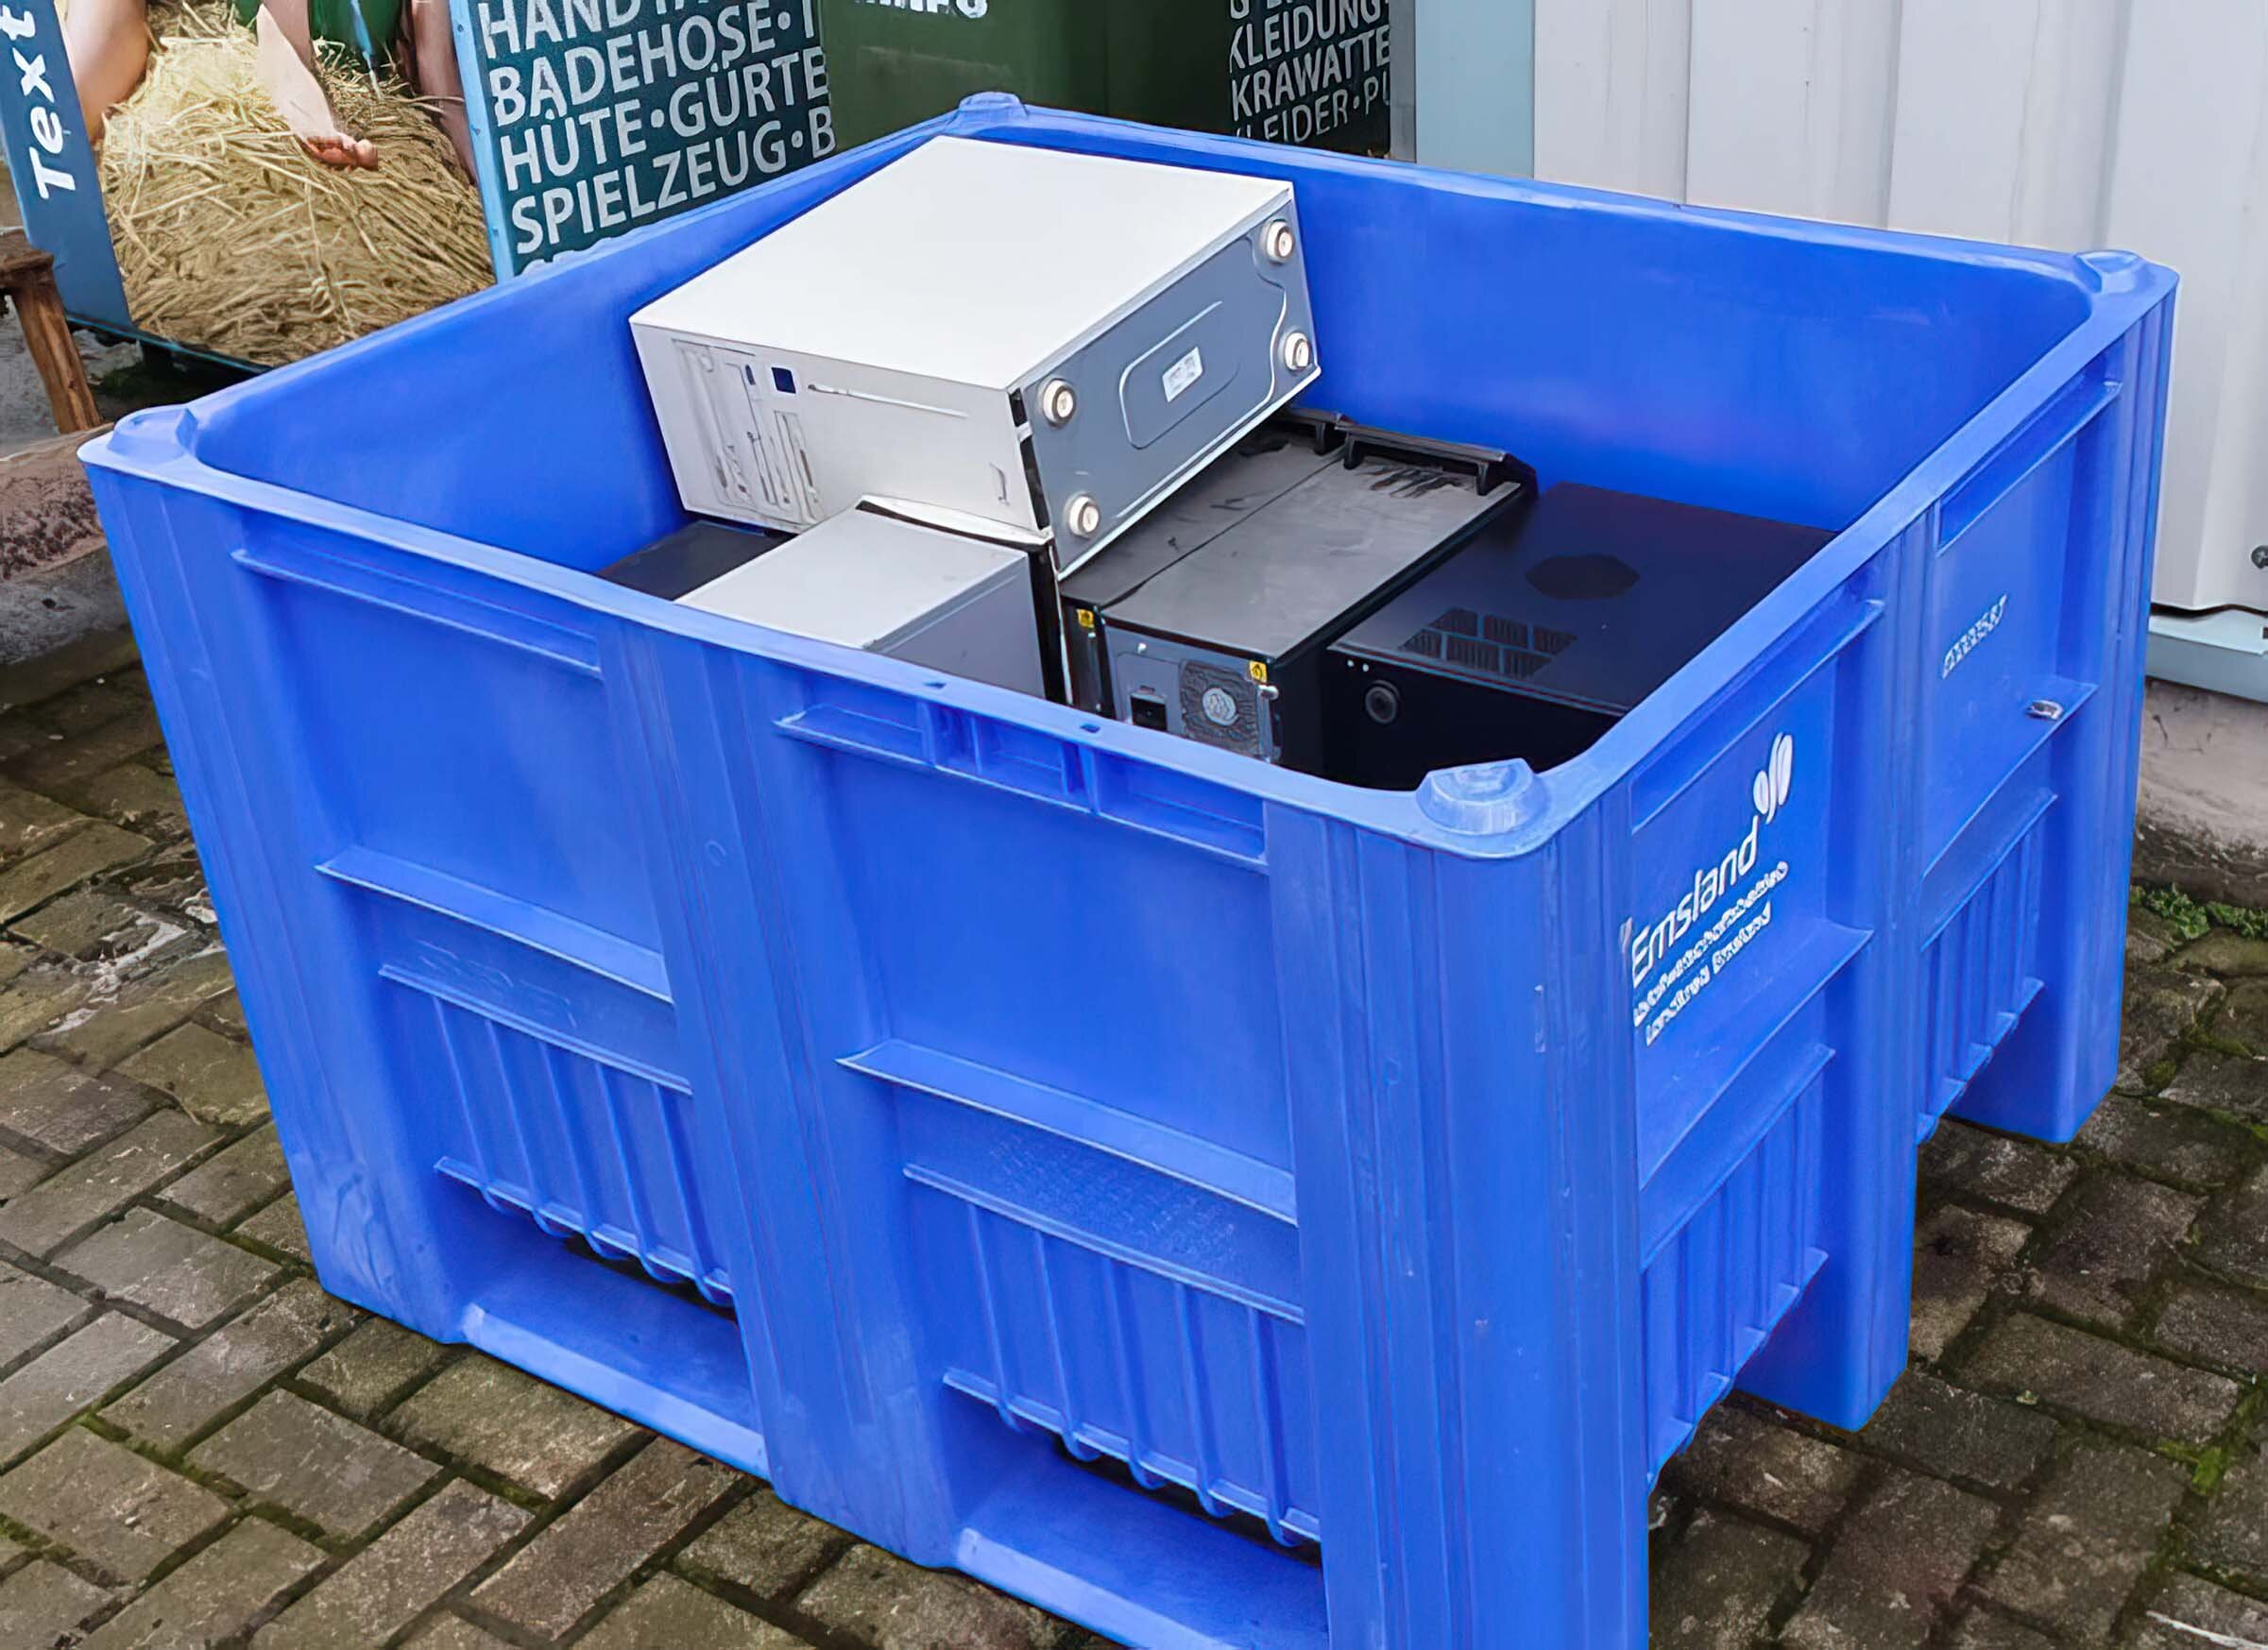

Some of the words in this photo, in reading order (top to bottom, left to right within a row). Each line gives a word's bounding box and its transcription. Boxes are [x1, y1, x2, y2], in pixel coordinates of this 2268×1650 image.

[475, 0, 710, 59] HAND
[489, 2, 776, 128] BADEHOSE
[0, 4, 76, 199] Text
[501, 98, 646, 191] HÜTE
[1236, 89, 1348, 143] EIDER
[512, 120, 787, 254] SPIELZEUG
[1632, 814, 1759, 989] Emsland
